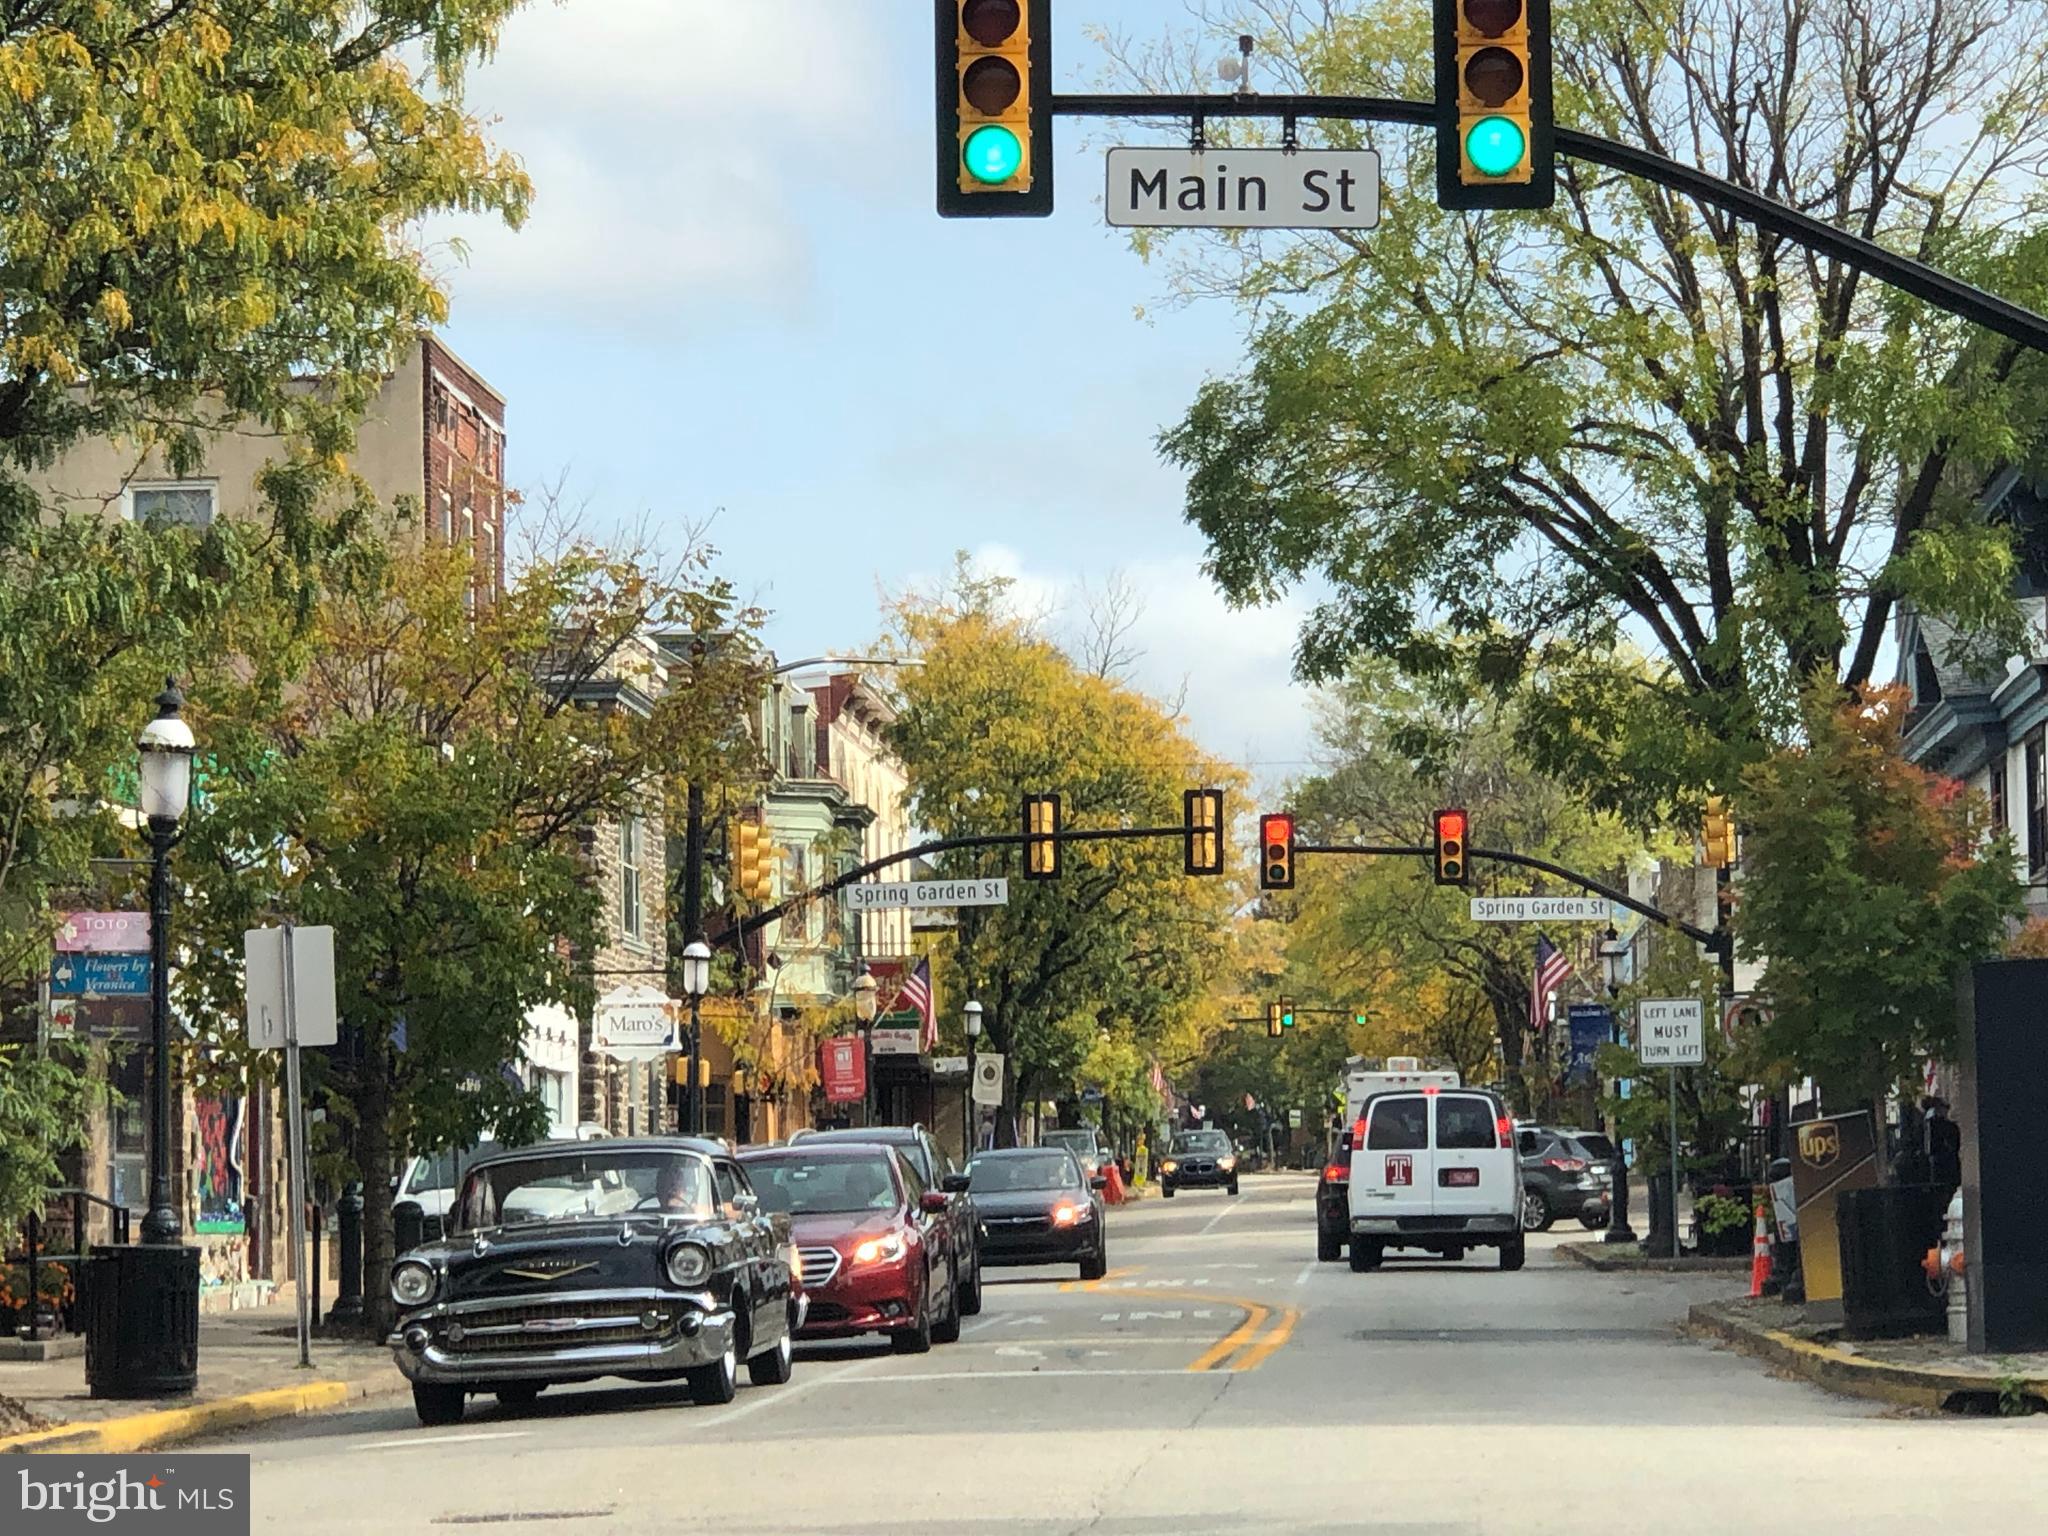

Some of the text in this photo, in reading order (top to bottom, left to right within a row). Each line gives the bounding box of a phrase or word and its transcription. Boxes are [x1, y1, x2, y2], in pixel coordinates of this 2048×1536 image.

[1129, 164, 1356, 212] Main St
[854, 882, 1000, 906] Spring Garden St
[1478, 901, 1604, 918] Spring Garden St
[84, 958, 147, 976] Flowers by
[85, 977, 135, 990] Veronica
[1644, 1007, 1697, 1018] LEFT LANE
[610, 1015, 663, 1032] Maro's
[1654, 1025, 1688, 1038] MUST
[1644, 1045, 1699, 1056] TURN LEFT
[1802, 1136, 1838, 1162] ups
